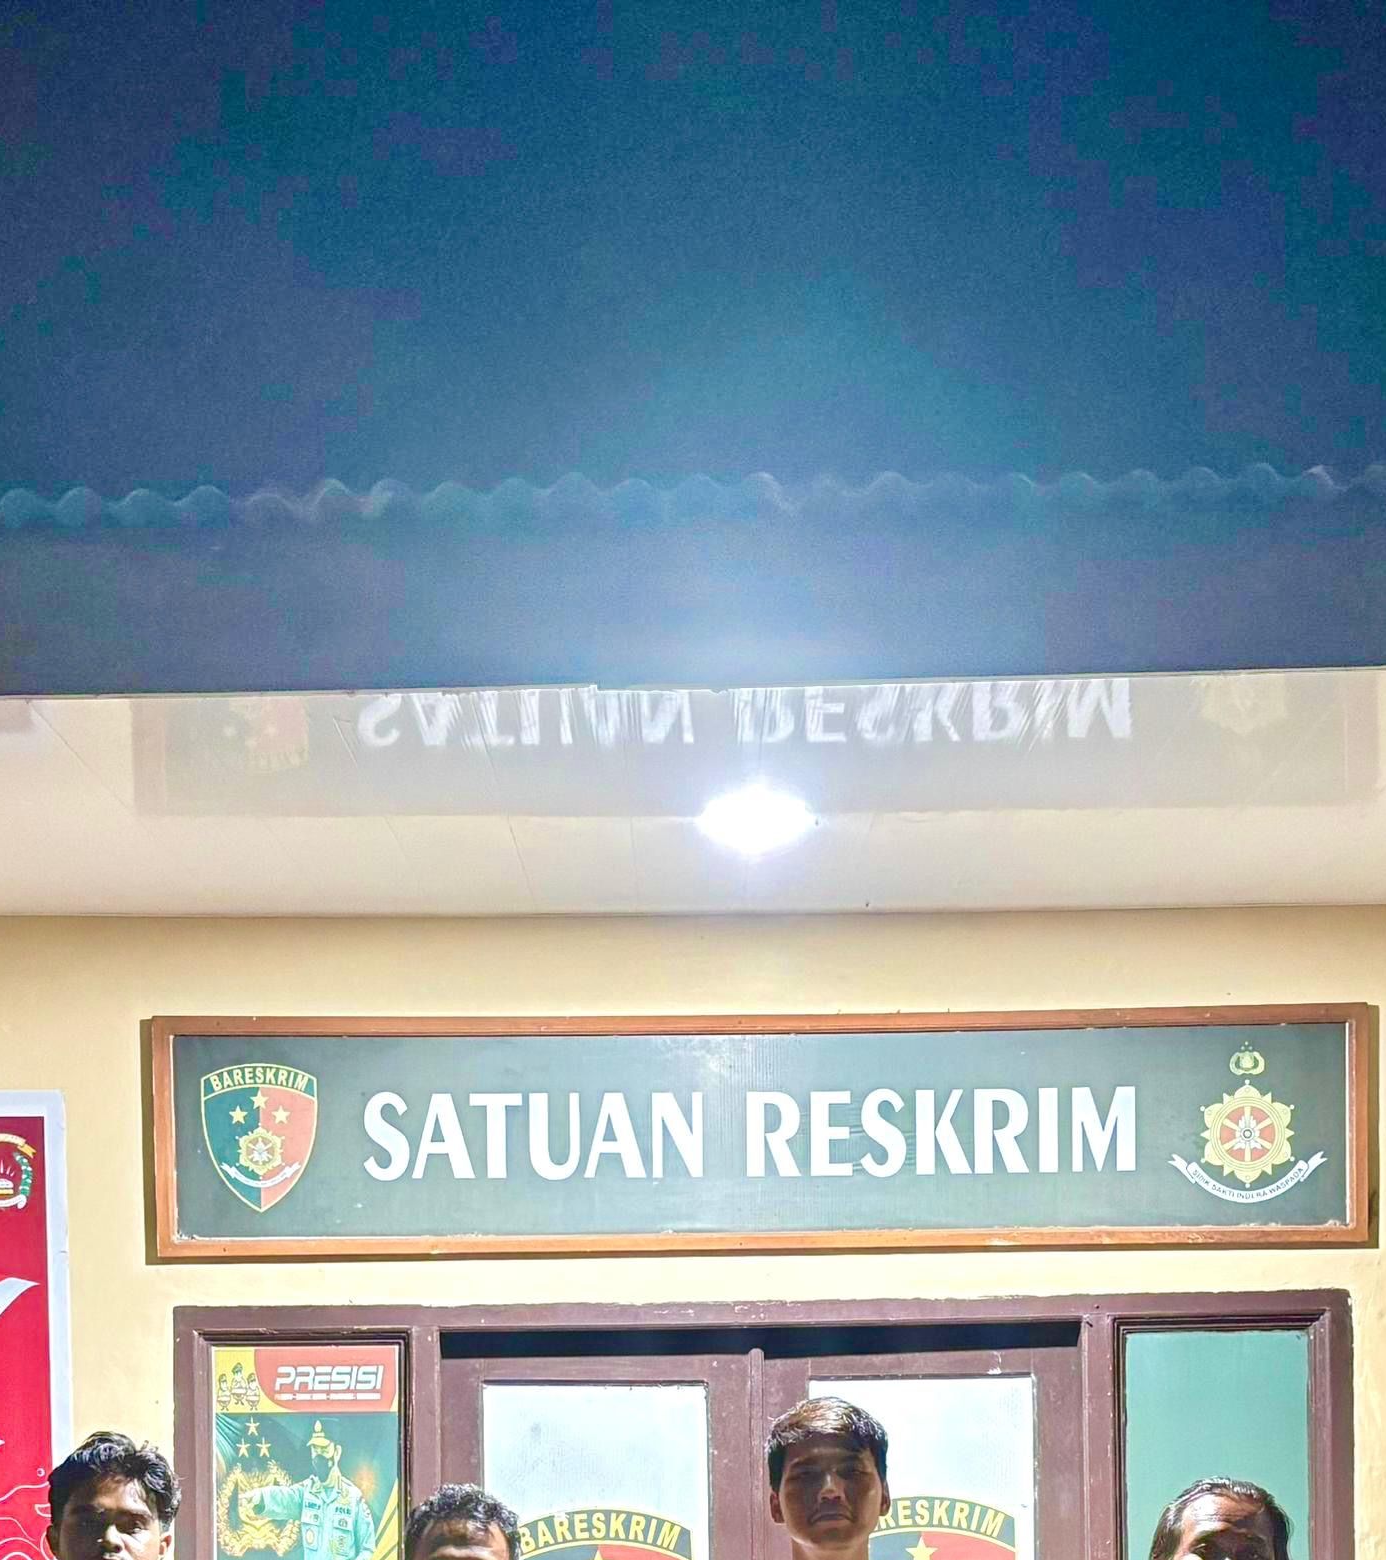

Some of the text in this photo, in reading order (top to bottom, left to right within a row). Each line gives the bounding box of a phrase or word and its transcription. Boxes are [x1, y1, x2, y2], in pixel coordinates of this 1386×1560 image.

[209, 1066, 309, 1092] BARESKRIM
[362, 1085, 1137, 1182] SATUAN RESKRIM
[274, 1364, 385, 1392] PRESISI
[518, 1511, 683, 1554] BARESKRIM
